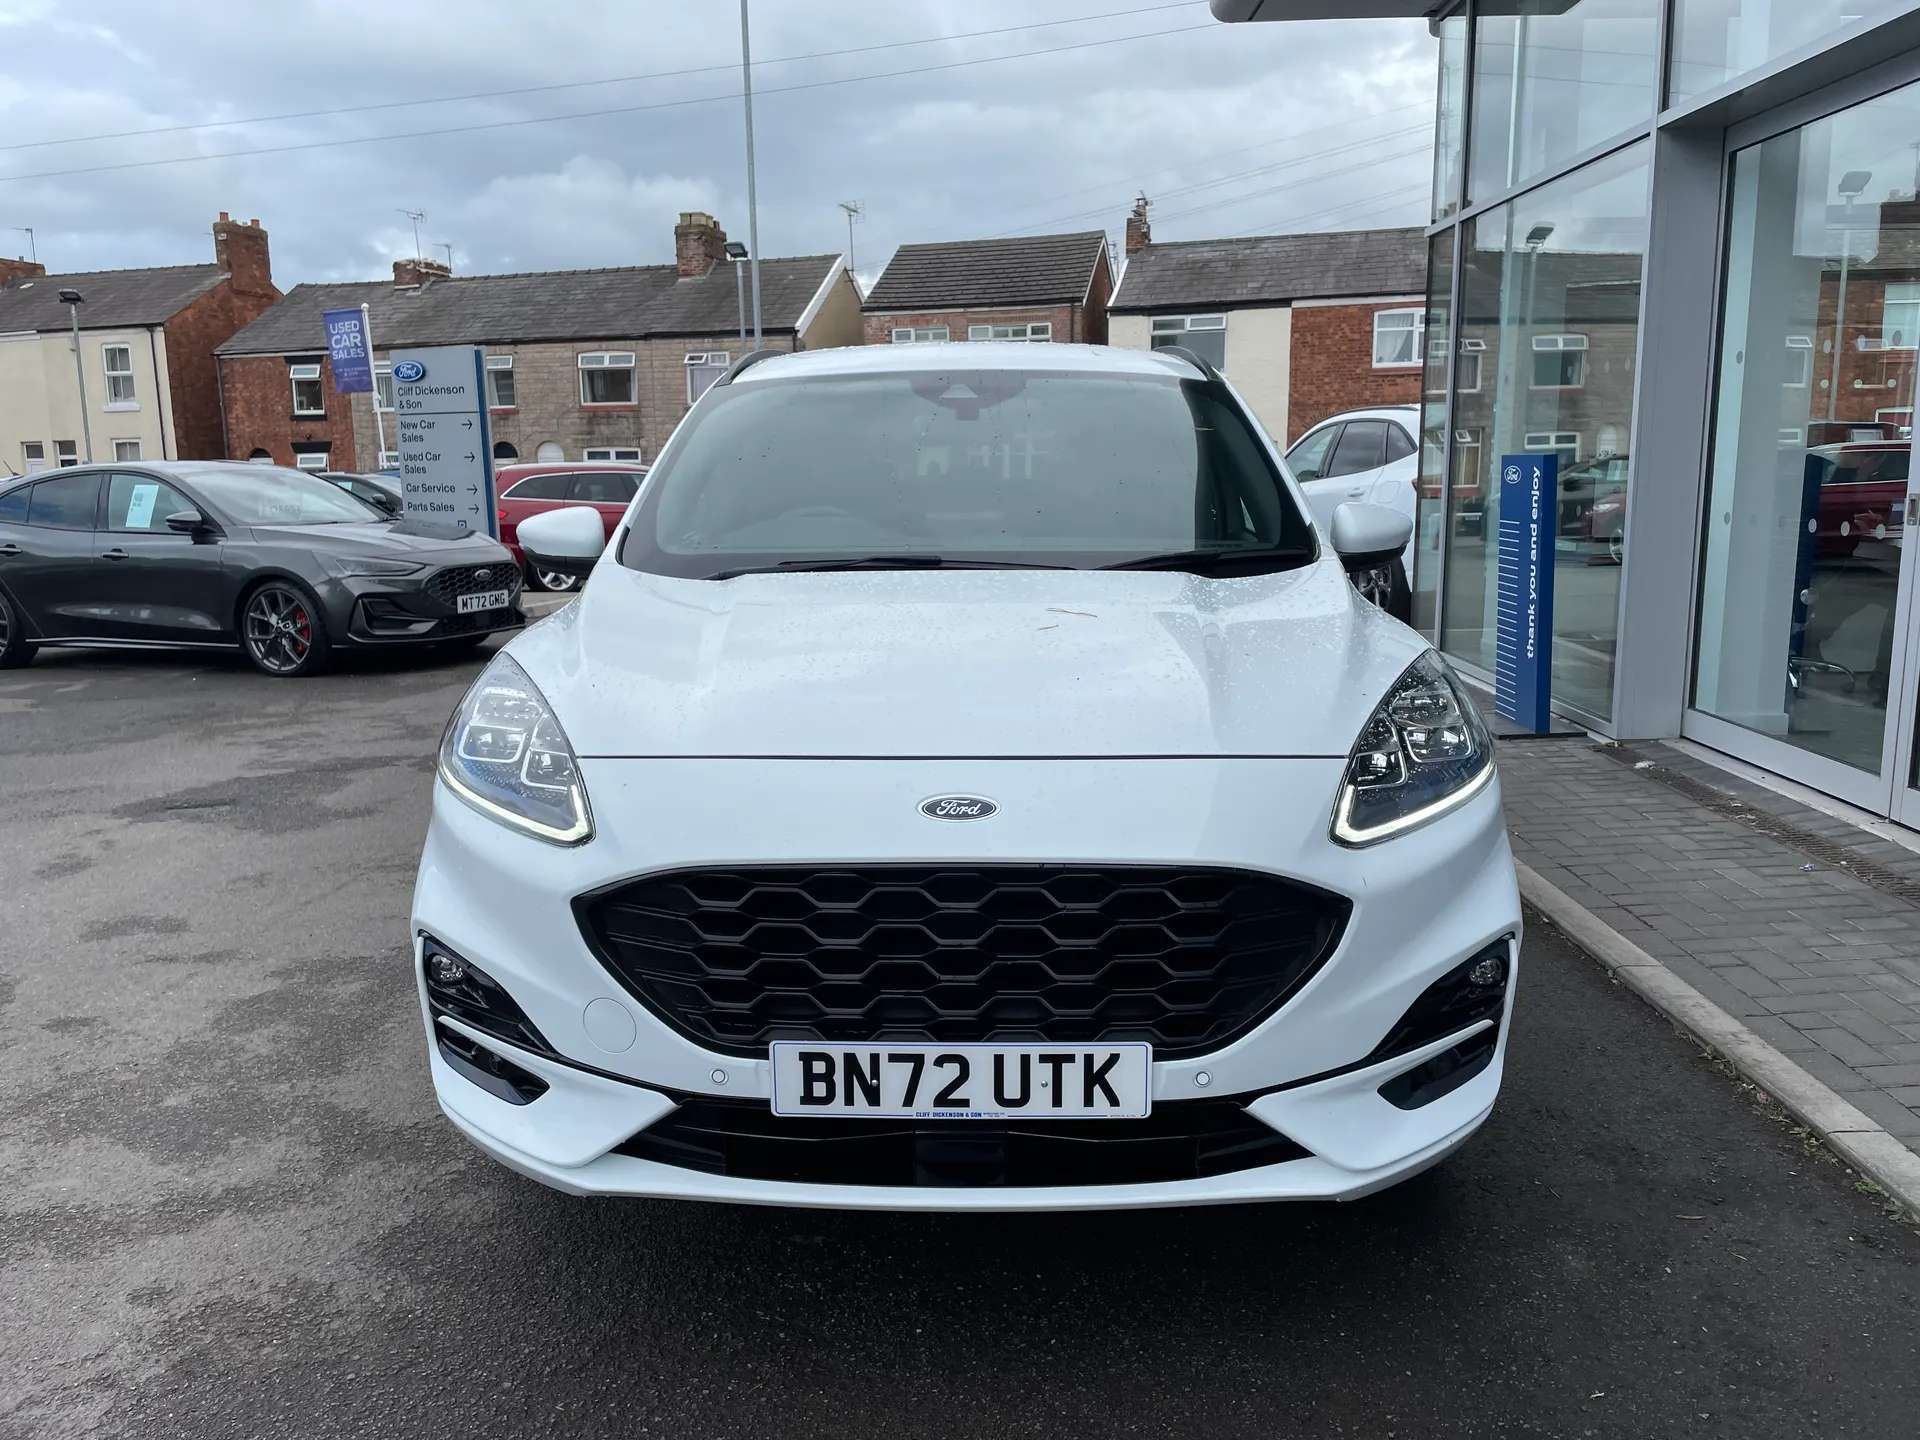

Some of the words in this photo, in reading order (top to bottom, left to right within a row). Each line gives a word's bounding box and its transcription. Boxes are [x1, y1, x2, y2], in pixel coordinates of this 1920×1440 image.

[329, 320, 360, 334] USED
[331, 332, 362, 349] CAR
[332, 347, 365, 360] SALES
[397, 385, 413, 397] Cliff
[415, 385, 465, 396] Dickenson
[399, 399, 405, 409] &
[406, 399, 423, 409] Son
[400, 421, 418, 430] New
[419, 419, 436, 430] Car
[401, 432, 424, 443] Sales
[403, 452, 424, 462] Used
[425, 451, 441, 461] Car
[404, 464, 427, 474] Sales
[406, 483, 420, 493] Car
[421, 483, 456, 493] Service
[1531, 465, 1541, 520] enjoy
[407, 501, 428, 512] Parts
[429, 502, 455, 512] Sales
[1530, 523, 1538, 562] and
[1529, 564, 1537, 600] you
[461, 595, 487, 610] MT72
[1526, 603, 1536, 660] thank
[936, 799, 981, 815] Ford
[798, 1051, 970, 1108] BN72
[993, 1053, 1121, 1108] UTK
